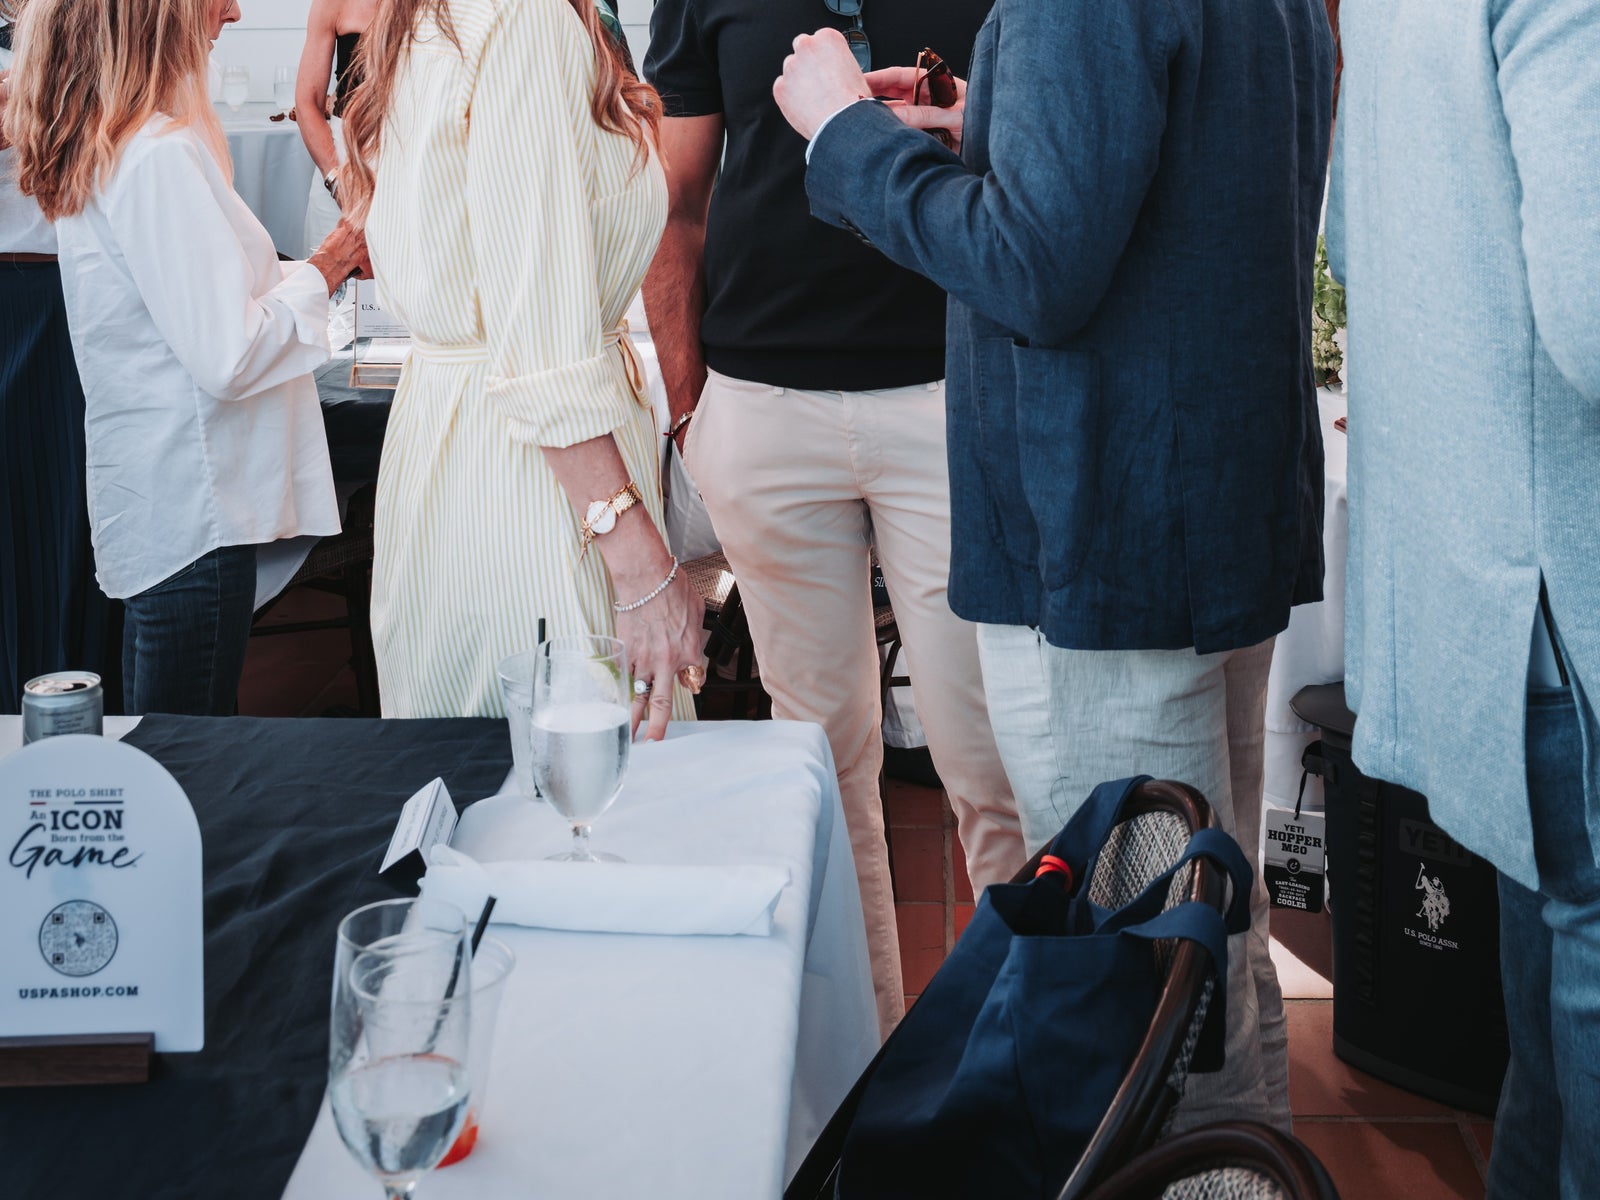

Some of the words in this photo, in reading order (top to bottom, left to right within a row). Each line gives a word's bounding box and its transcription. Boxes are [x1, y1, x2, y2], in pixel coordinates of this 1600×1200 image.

[30, 789, 52, 798] THE
[56, 788, 86, 798] POLO
[89, 788, 124, 798] SHIRT
[30, 810, 46, 820] An
[50, 809, 124, 831] ICON
[1284, 823, 1305, 834] YETI
[51, 834, 77, 843] Born
[80, 833, 105, 842] from
[108, 833, 124, 842] the
[1268, 829, 1322, 848] HOPPER
[9, 822, 145, 880] Game
[1281, 843, 1308, 856] M20
[1276, 897, 1308, 910] COOLER
[1417, 931, 1437, 943] POLO
[19, 986, 139, 999] USPASHOP.COM
